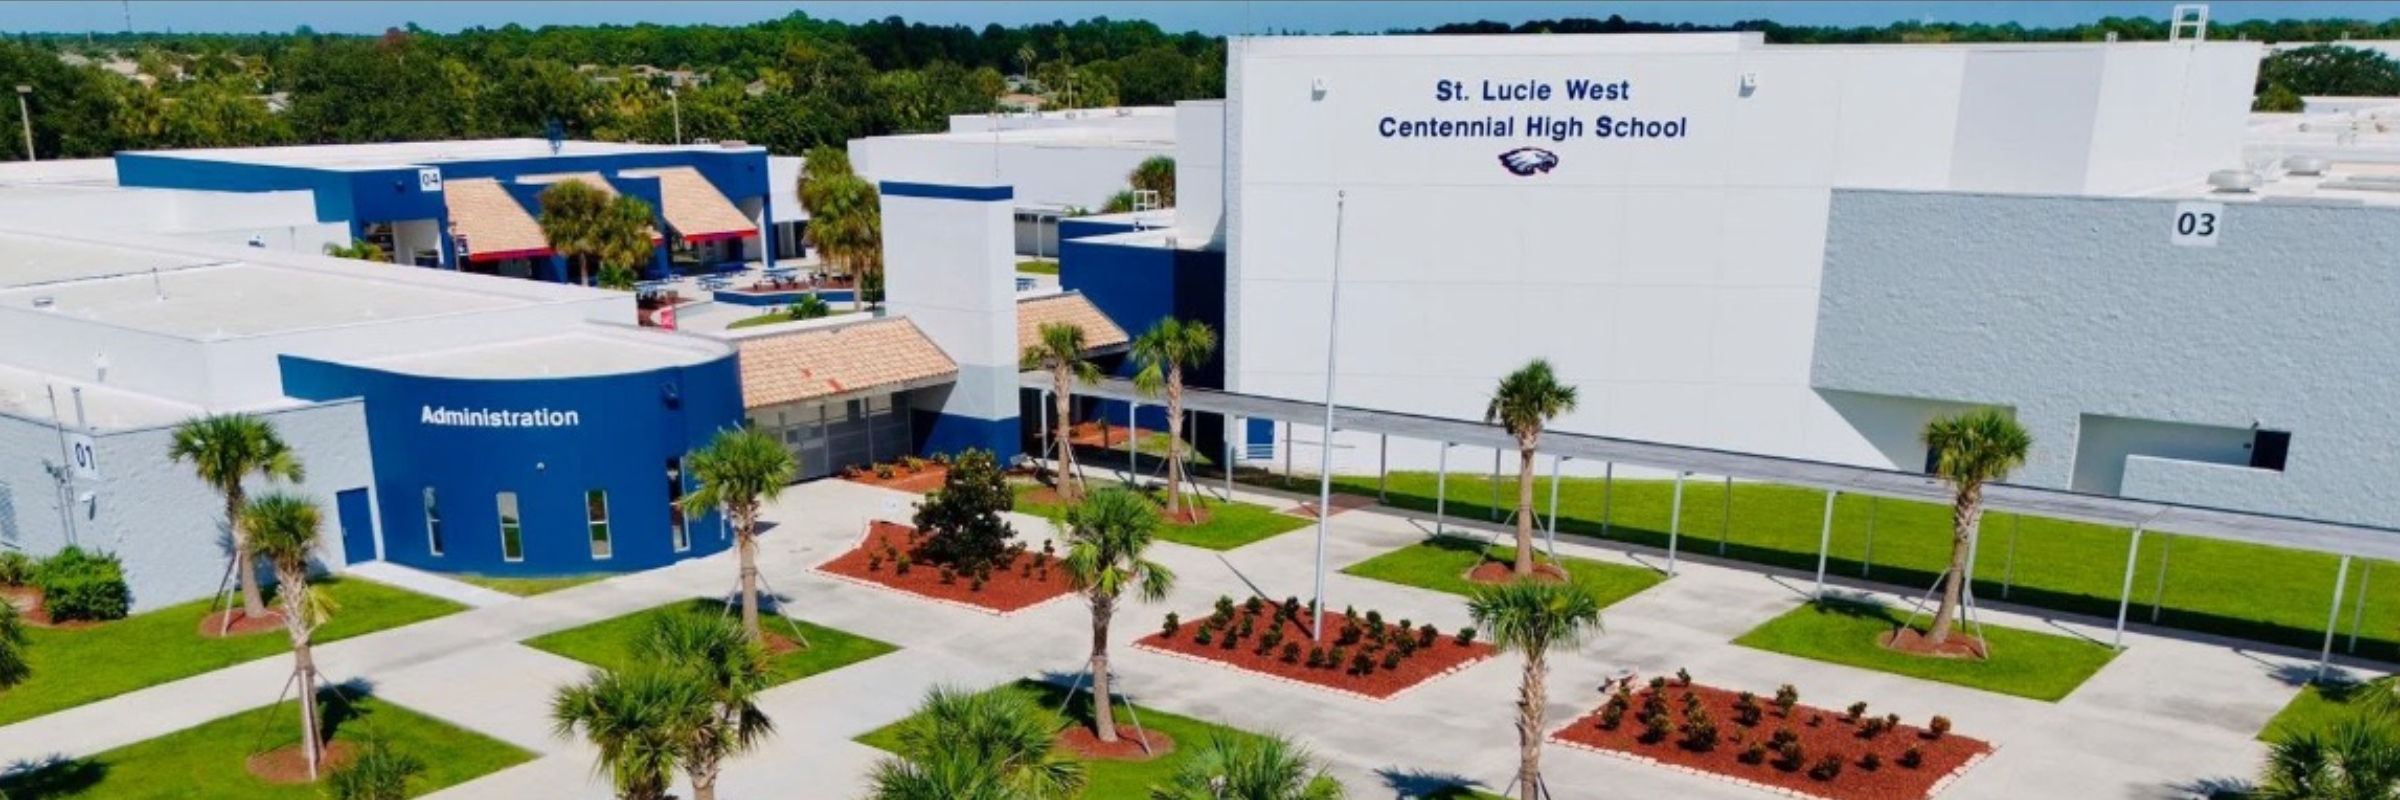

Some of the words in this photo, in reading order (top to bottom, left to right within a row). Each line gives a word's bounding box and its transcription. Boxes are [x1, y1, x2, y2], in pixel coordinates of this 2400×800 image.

[1435, 79, 1470, 101] St.
[1483, 80, 1551, 101] Lucie
[1566, 80, 1629, 101] West
[1379, 116, 1514, 138] Centennial
[1527, 116, 1583, 142] High
[1596, 115, 1687, 138] School
[422, 173, 440, 186] 04
[2177, 212, 2216, 237] 03
[421, 404, 579, 428] Administration
[74, 442, 95, 469] 01
